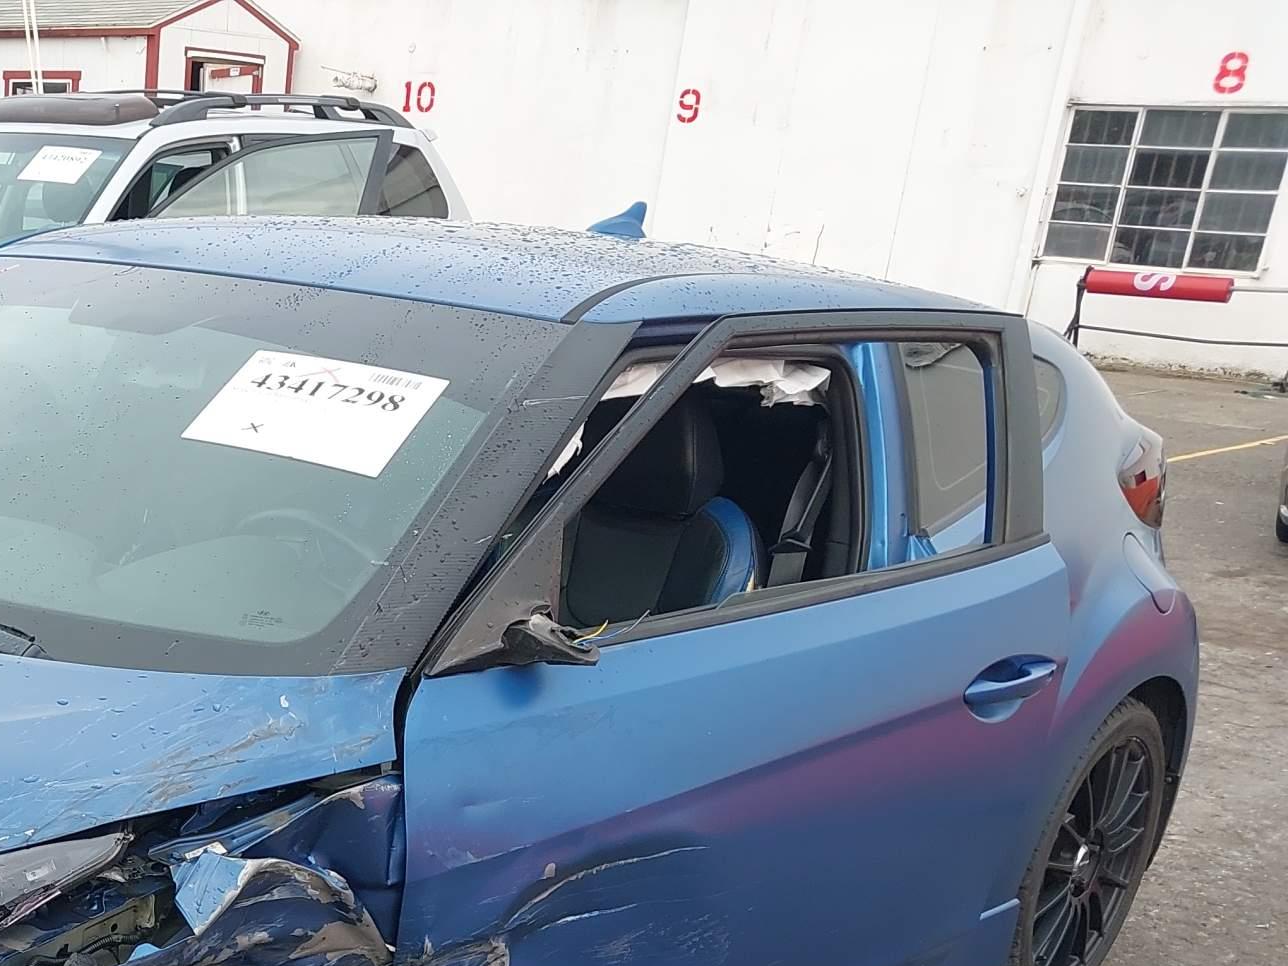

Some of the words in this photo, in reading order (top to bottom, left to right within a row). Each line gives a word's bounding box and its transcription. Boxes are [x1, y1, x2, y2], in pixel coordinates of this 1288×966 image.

[1213, 51, 1249, 94] 8
[402, 81, 436, 113] 10
[676, 88, 702, 124] 9
[250, 373, 406, 412] 43417298
